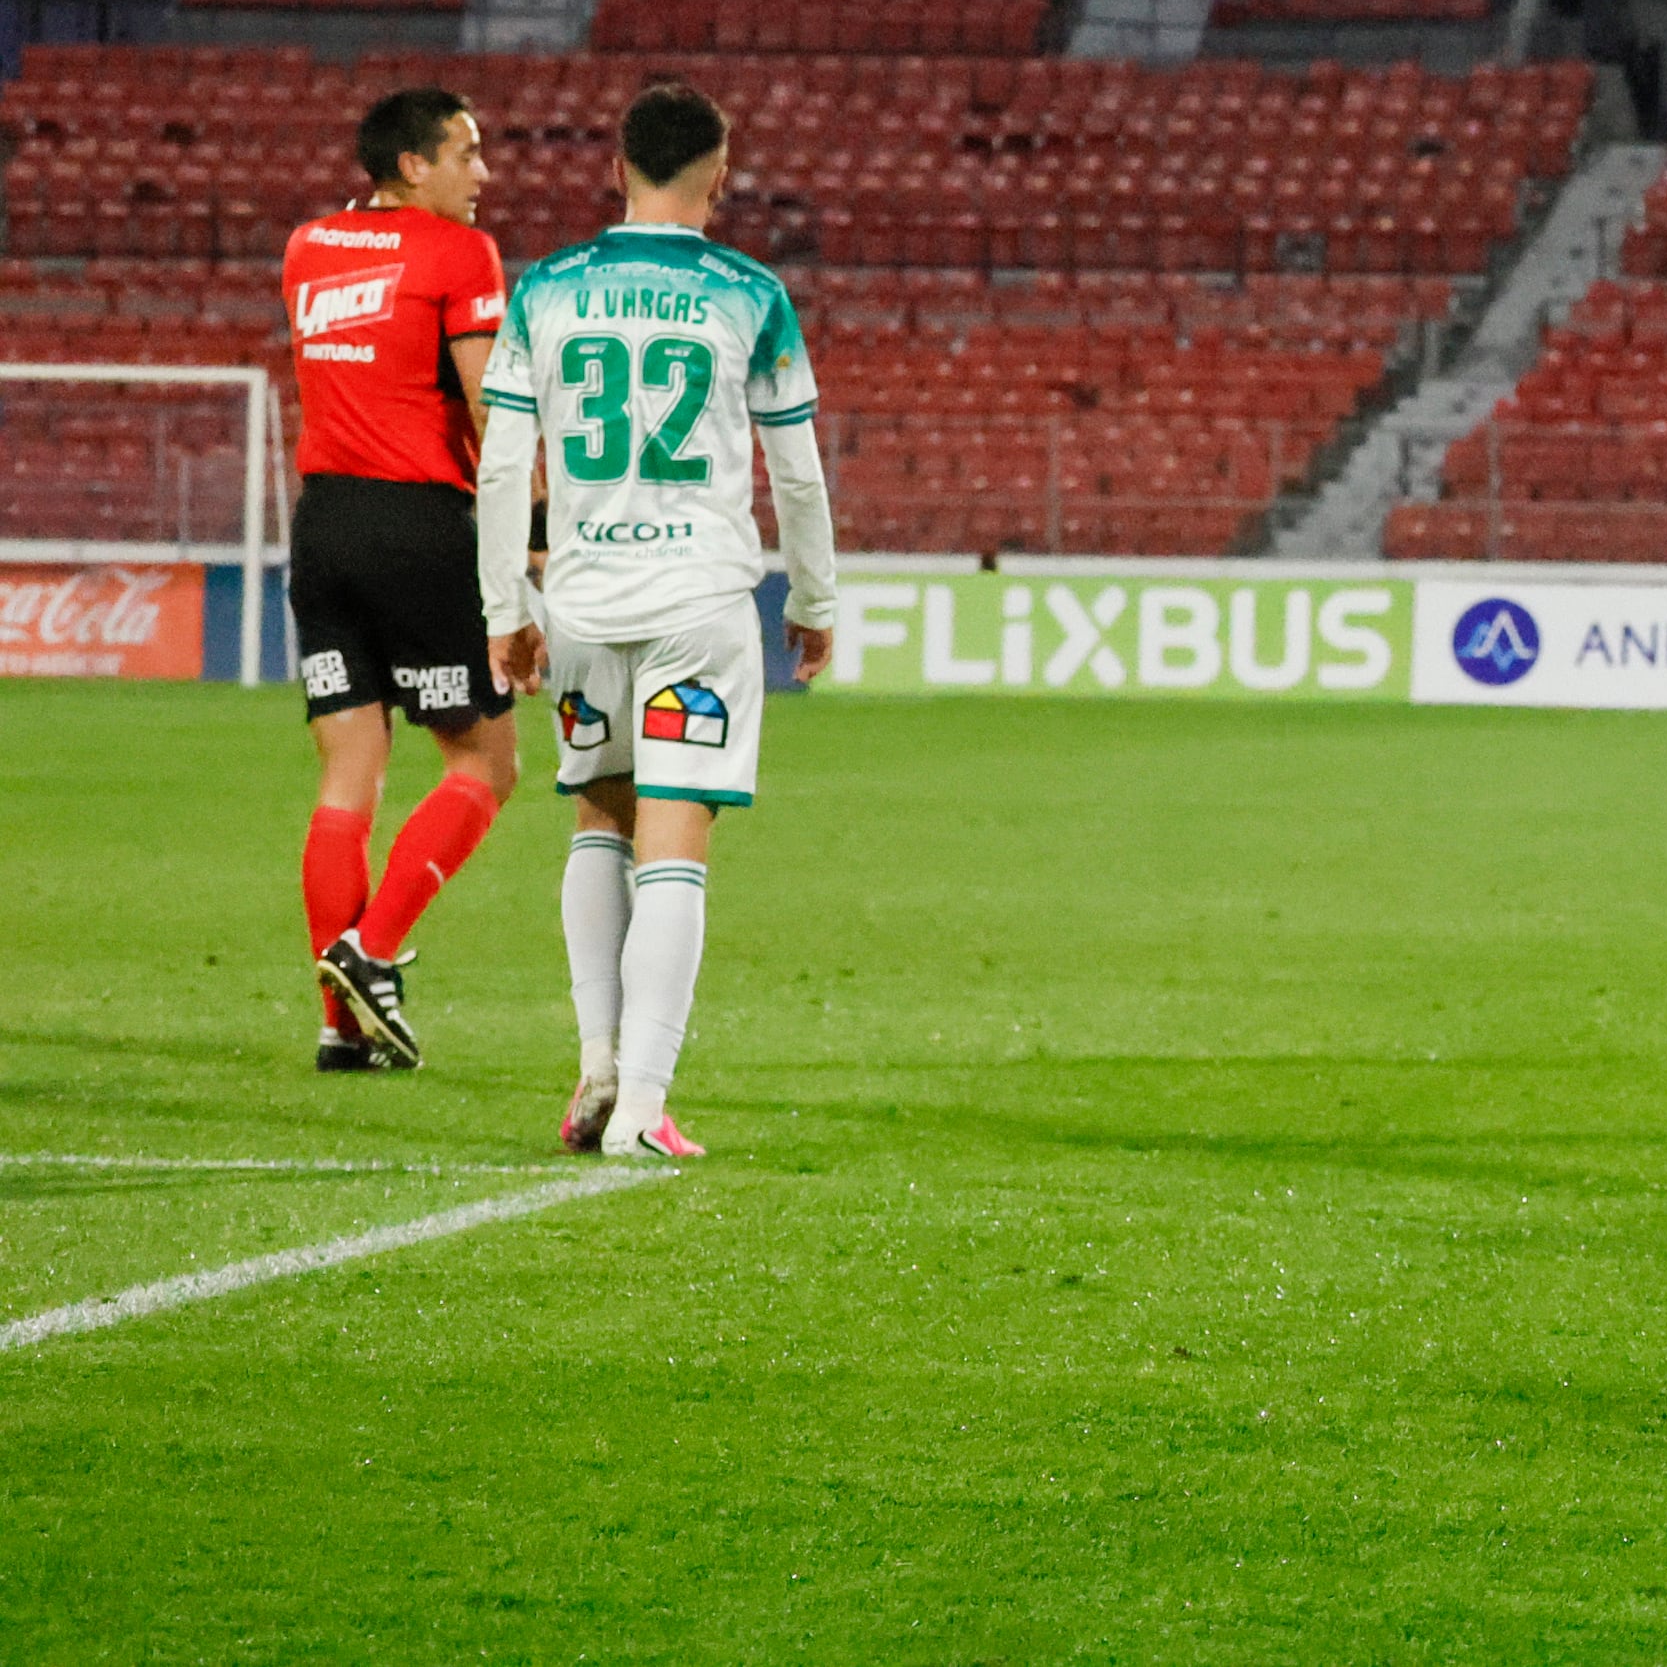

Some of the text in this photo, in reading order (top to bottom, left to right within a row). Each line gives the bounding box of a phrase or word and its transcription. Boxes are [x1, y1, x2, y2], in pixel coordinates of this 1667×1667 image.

[296, 277, 388, 339] LANCO
[576, 287, 711, 324] V.VARGAS
[559, 332, 715, 485] 32
[577, 520, 692, 543] RICOH
[305, 671, 351, 700] ADE
[418, 685, 471, 711] ADE
